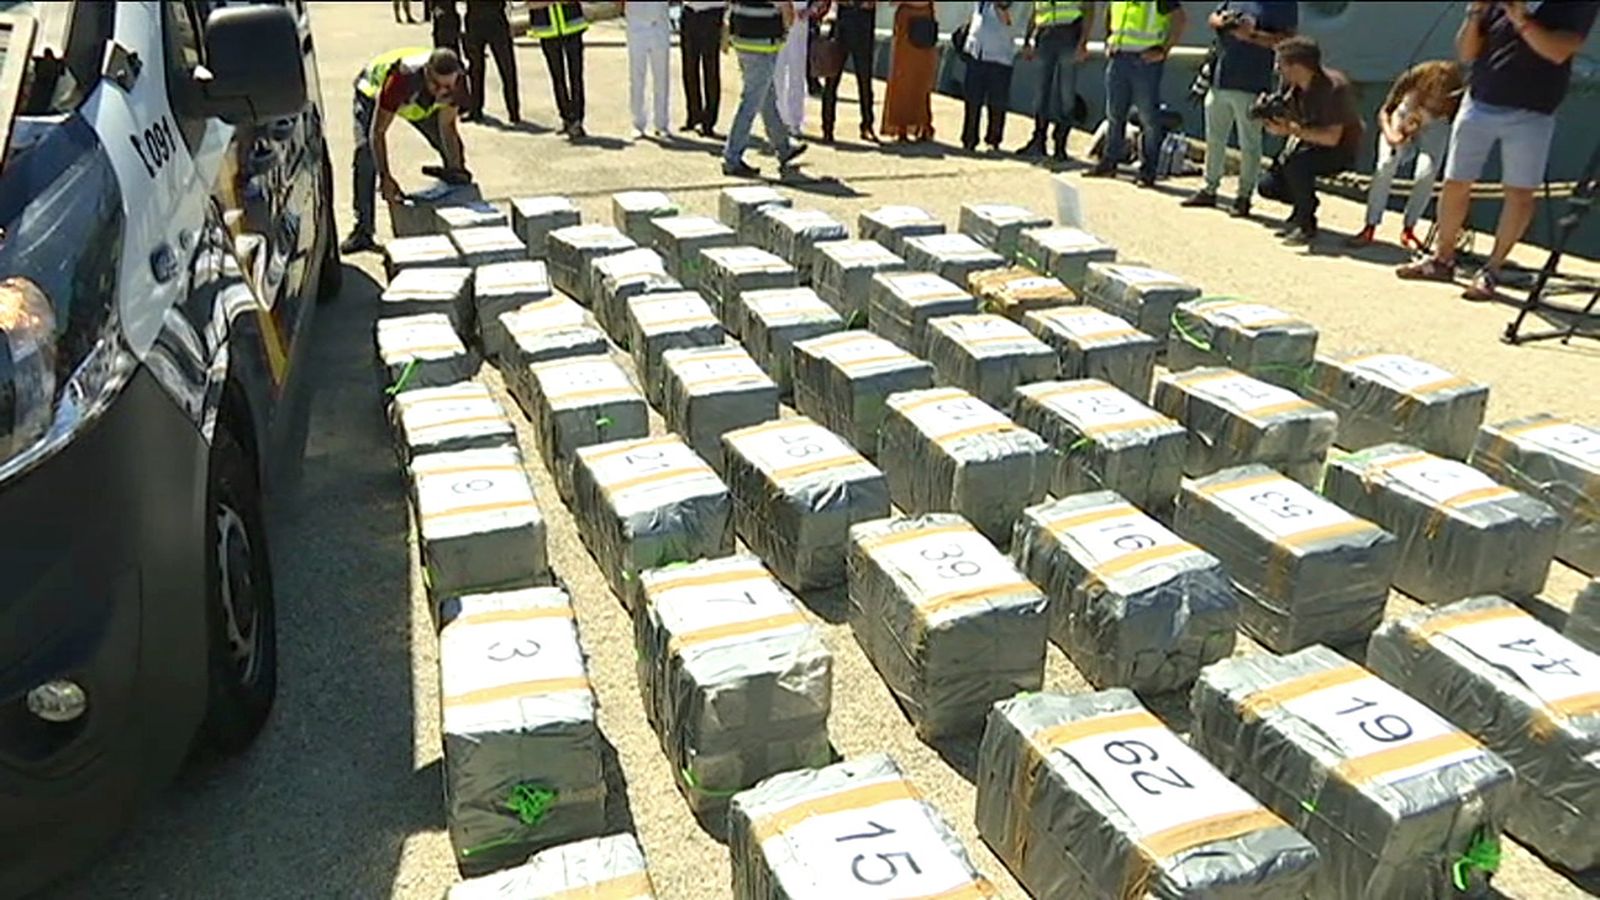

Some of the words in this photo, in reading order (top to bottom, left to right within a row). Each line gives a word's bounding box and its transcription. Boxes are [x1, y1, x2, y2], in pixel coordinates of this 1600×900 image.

[144, 115, 176, 168] 091
[920, 545, 982, 580] 39
[486, 638, 542, 663] 3
[1498, 638, 1582, 677] 44
[1335, 695, 1415, 745] 19
[834, 820, 923, 886] 15
